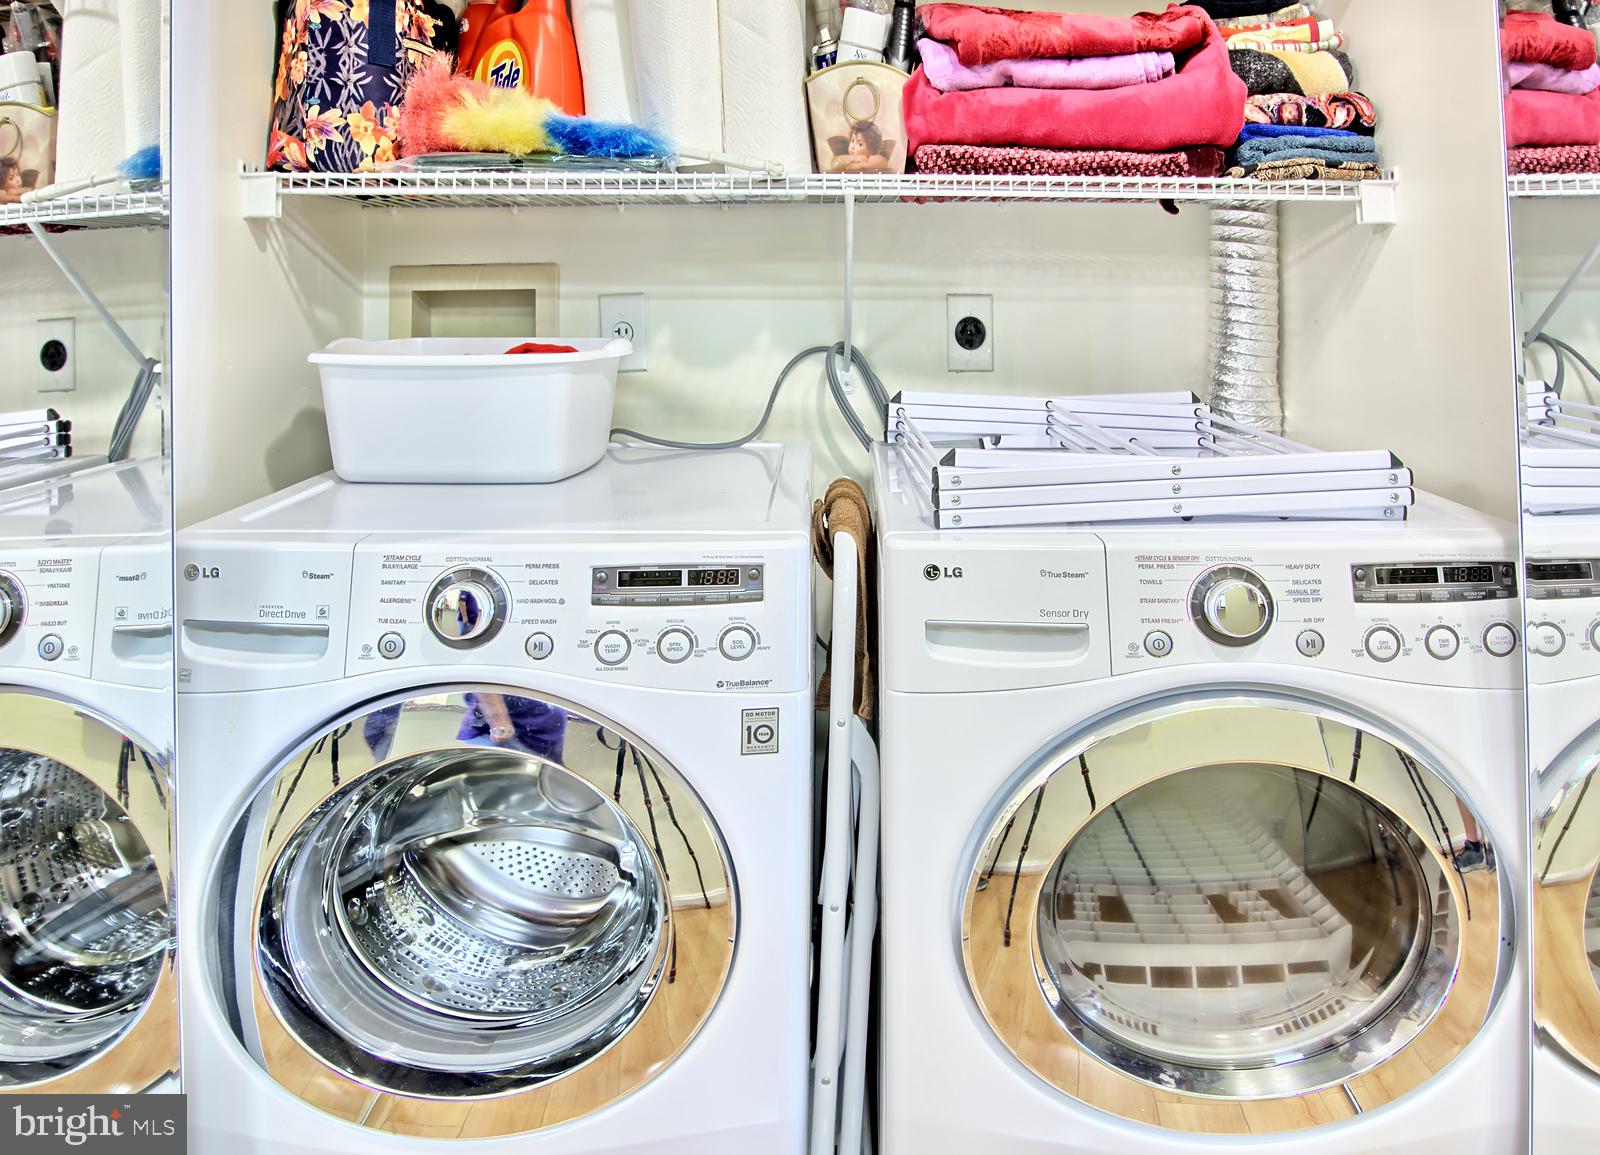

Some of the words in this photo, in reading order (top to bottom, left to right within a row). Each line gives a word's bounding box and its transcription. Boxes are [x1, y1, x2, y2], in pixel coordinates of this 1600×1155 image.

[490, 60, 520, 88] Tide
[202, 567, 220, 578] LG
[944, 567, 963, 578] LG
[1039, 609, 1071, 618] Sensor
[1072, 609, 1089, 619] Dry
[746, 724, 774, 744] 10
